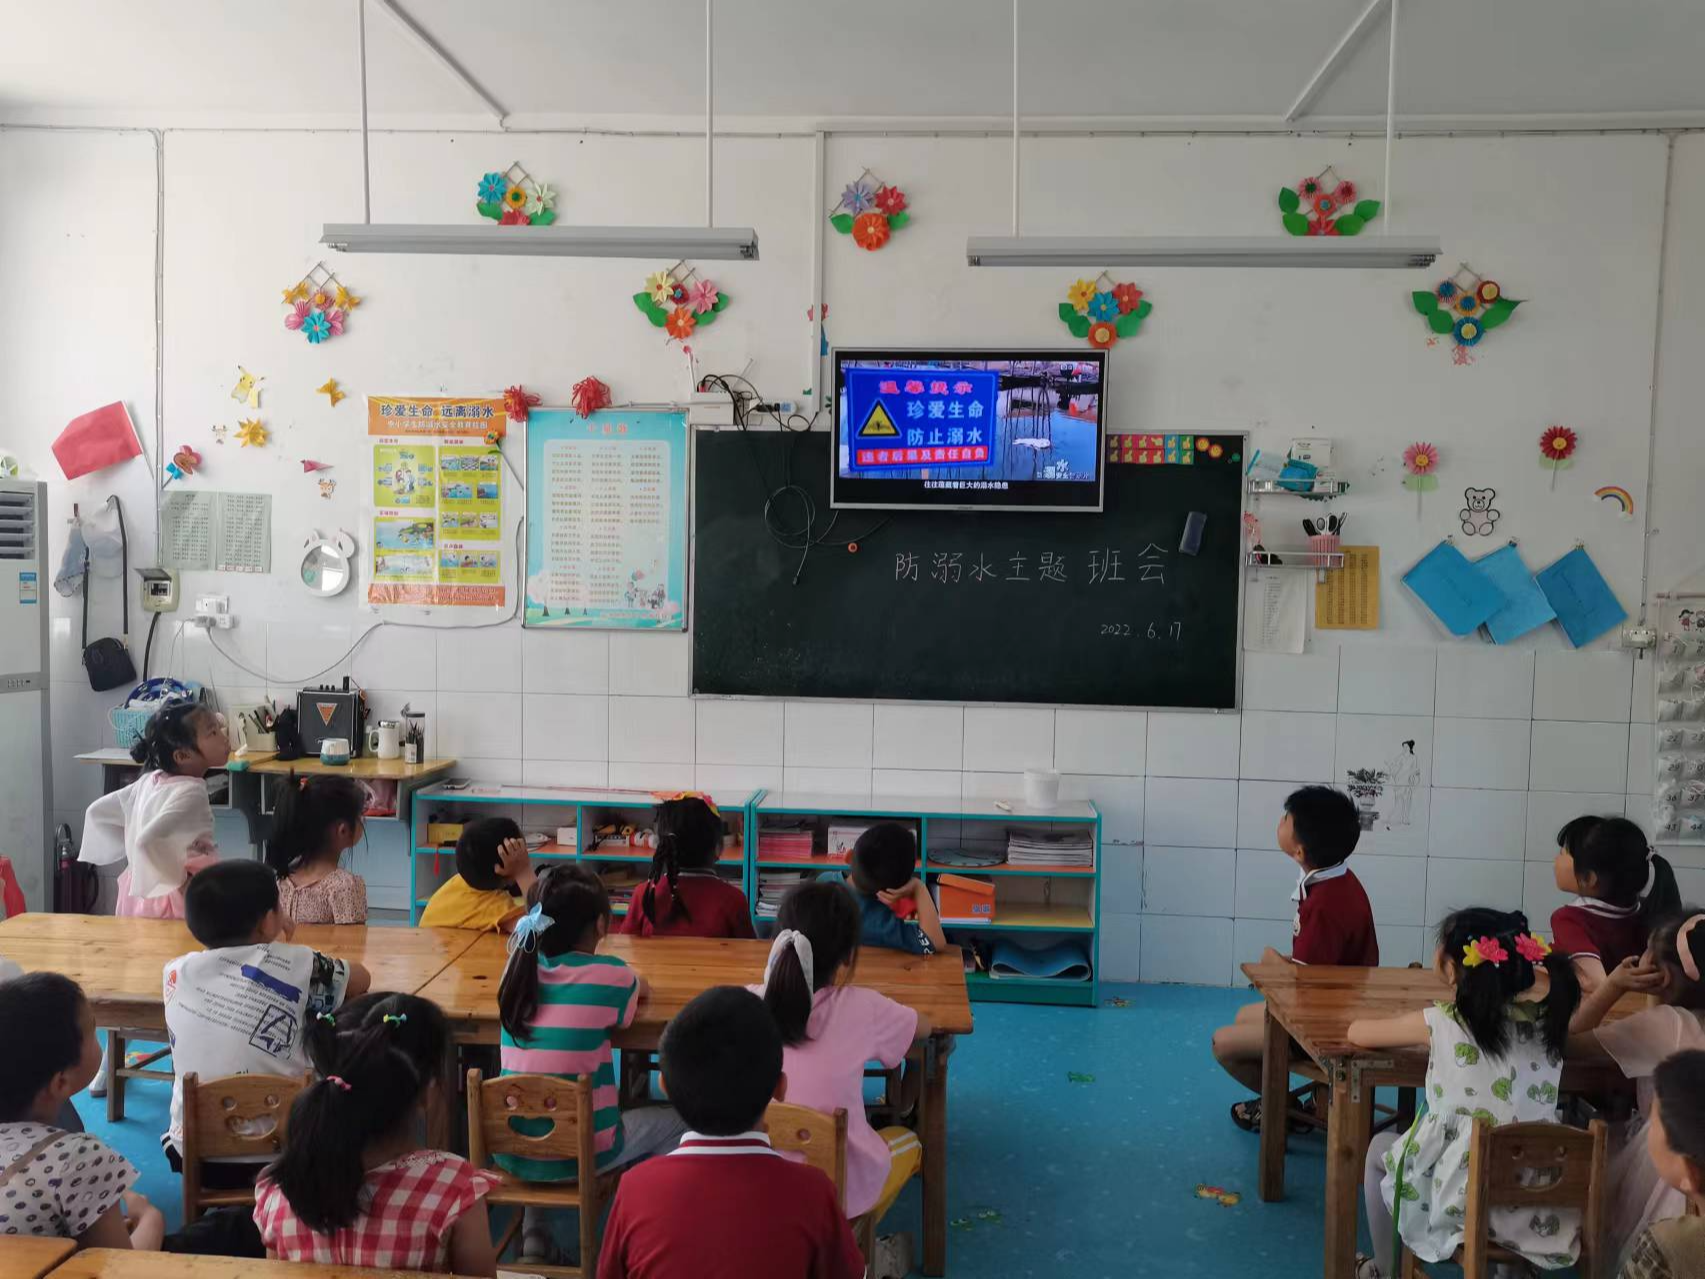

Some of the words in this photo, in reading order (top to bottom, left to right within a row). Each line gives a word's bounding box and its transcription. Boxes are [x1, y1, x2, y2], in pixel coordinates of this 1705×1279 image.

[381, 404, 434, 418] 珍爱生命
[441, 404, 494, 419] 远离溺水
[907, 400, 985, 419] 珍爱生命
[907, 427, 983, 447] 防止溺水
[895, 543, 1169, 585] 防溺水主题班会
